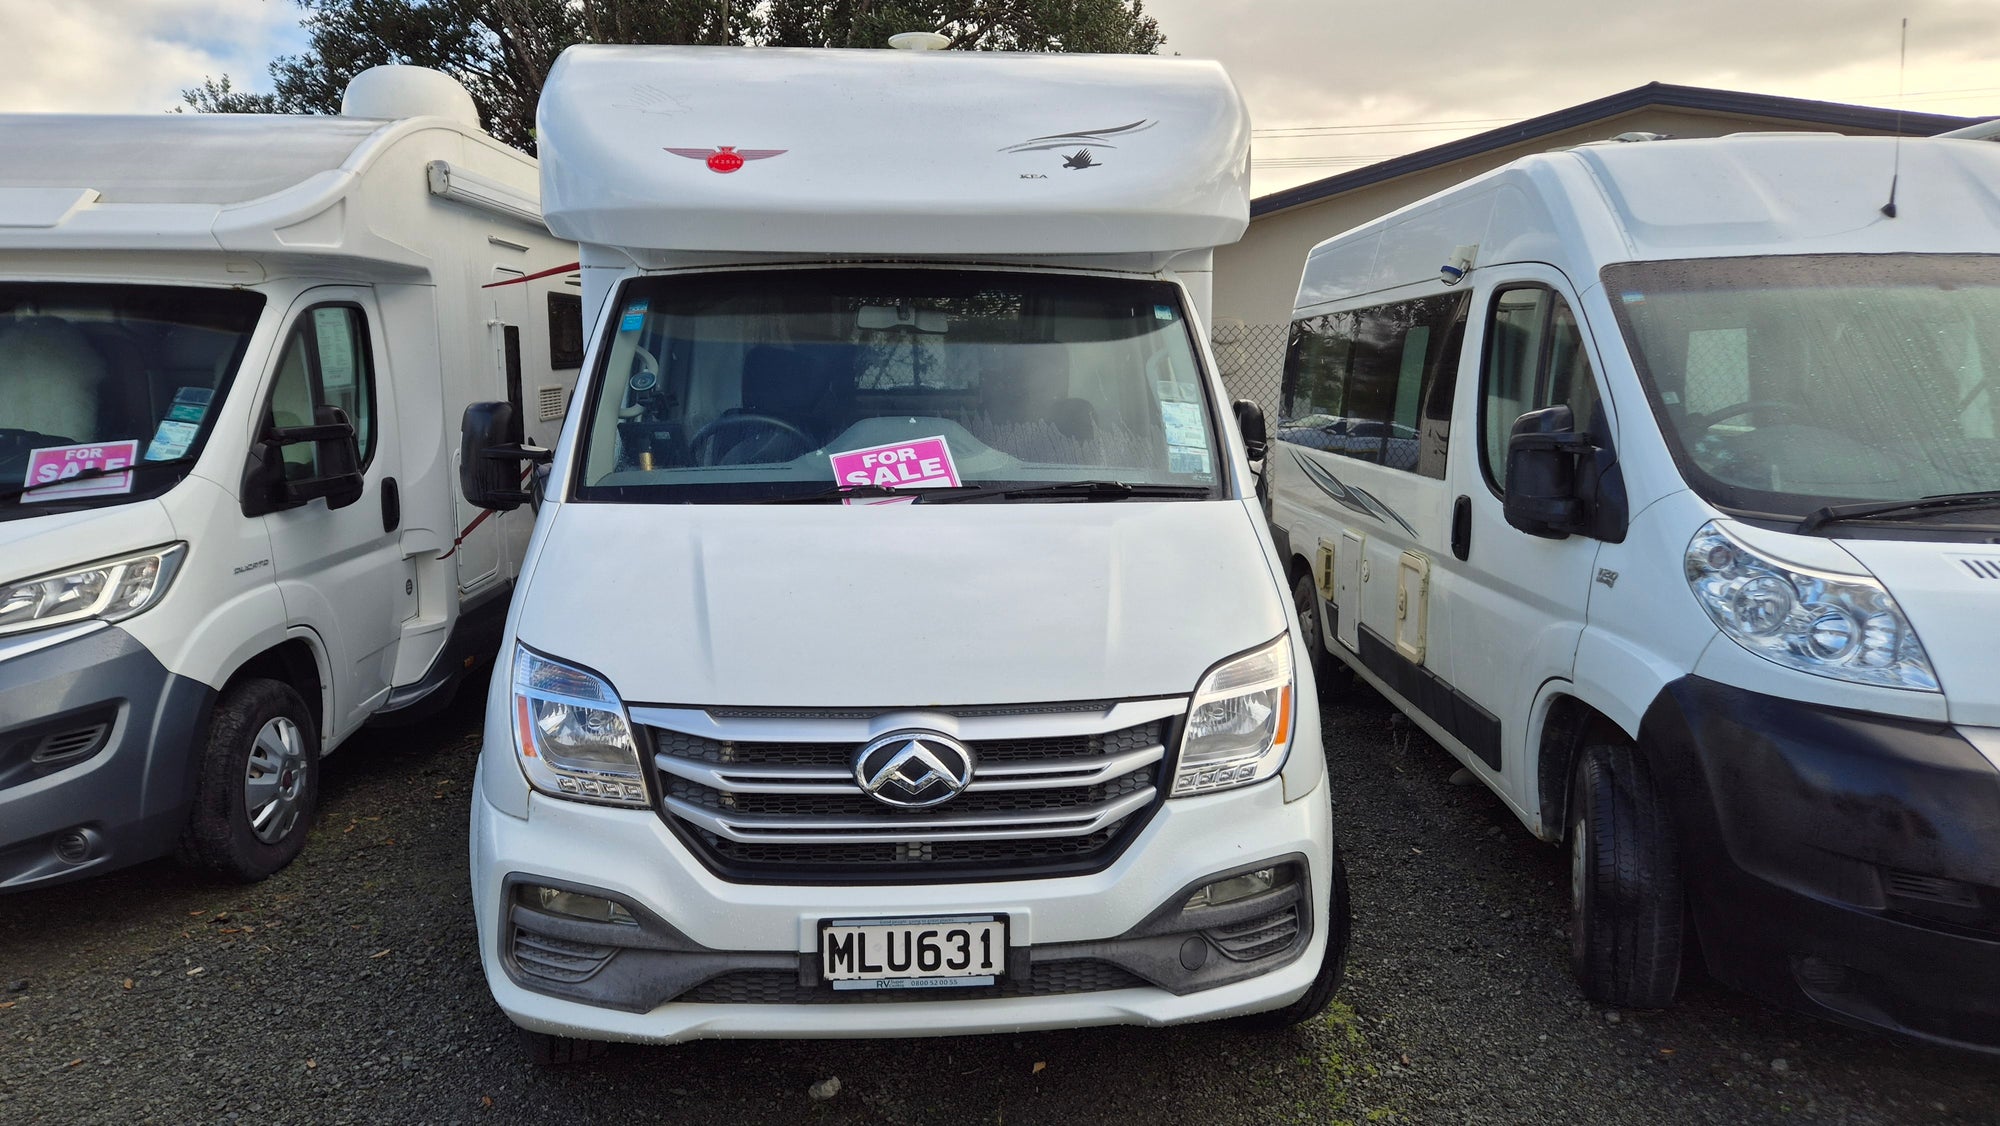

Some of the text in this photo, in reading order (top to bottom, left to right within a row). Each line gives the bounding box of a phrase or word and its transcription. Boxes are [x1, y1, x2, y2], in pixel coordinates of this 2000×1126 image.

[65, 447, 103, 460] FOR
[862, 448, 917, 468] FOR
[846, 457, 945, 485] SALE
[828, 928, 993, 974] MLU631
[876, 980, 890, 988] RV
